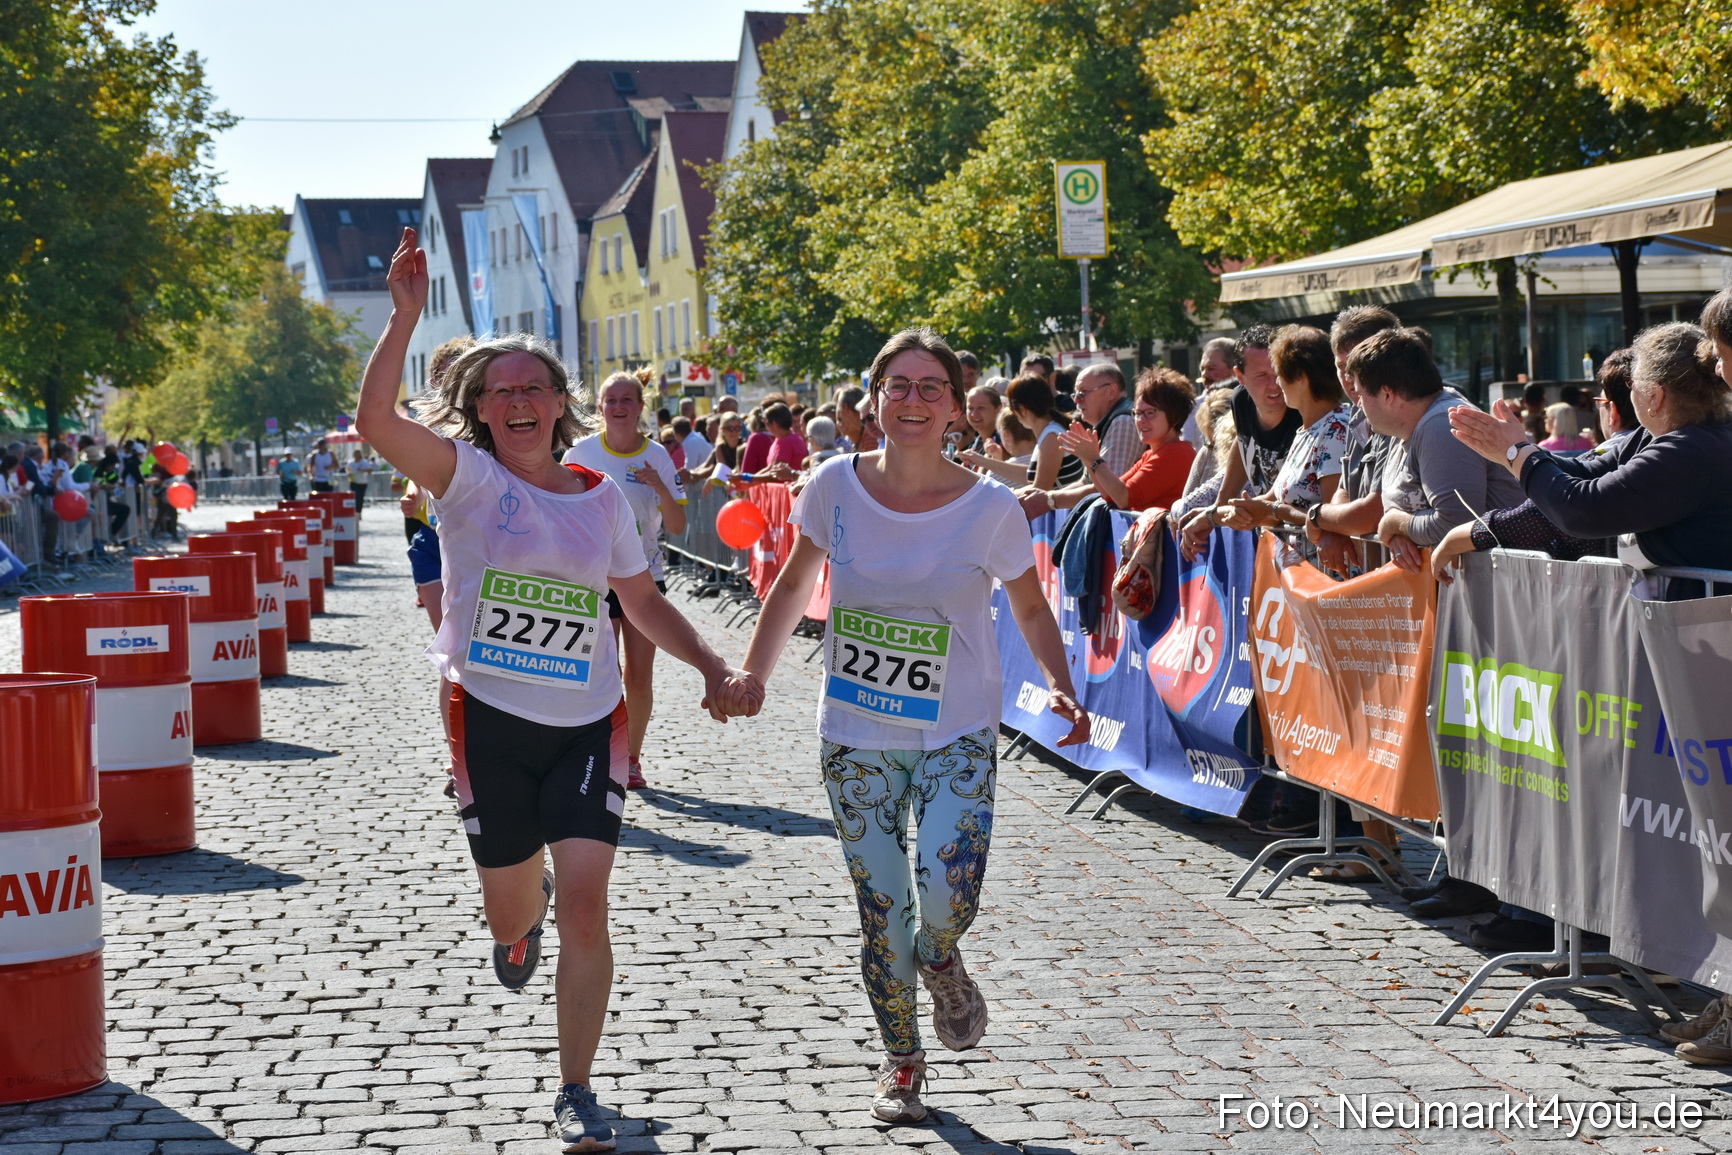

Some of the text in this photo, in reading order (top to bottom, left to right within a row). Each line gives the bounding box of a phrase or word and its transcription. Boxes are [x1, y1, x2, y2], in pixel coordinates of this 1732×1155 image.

[489, 575, 589, 614] BOCK
[1351, 594, 1386, 609] moderner
[1386, 593, 1413, 608] Partner
[486, 607, 585, 652] 2277
[840, 610, 940, 652] BOCK
[480, 647, 578, 676] KATHARINA
[842, 643, 932, 692] 2276
[857, 689, 903, 713] RUTH
[1441, 658, 1560, 760] BOCK
